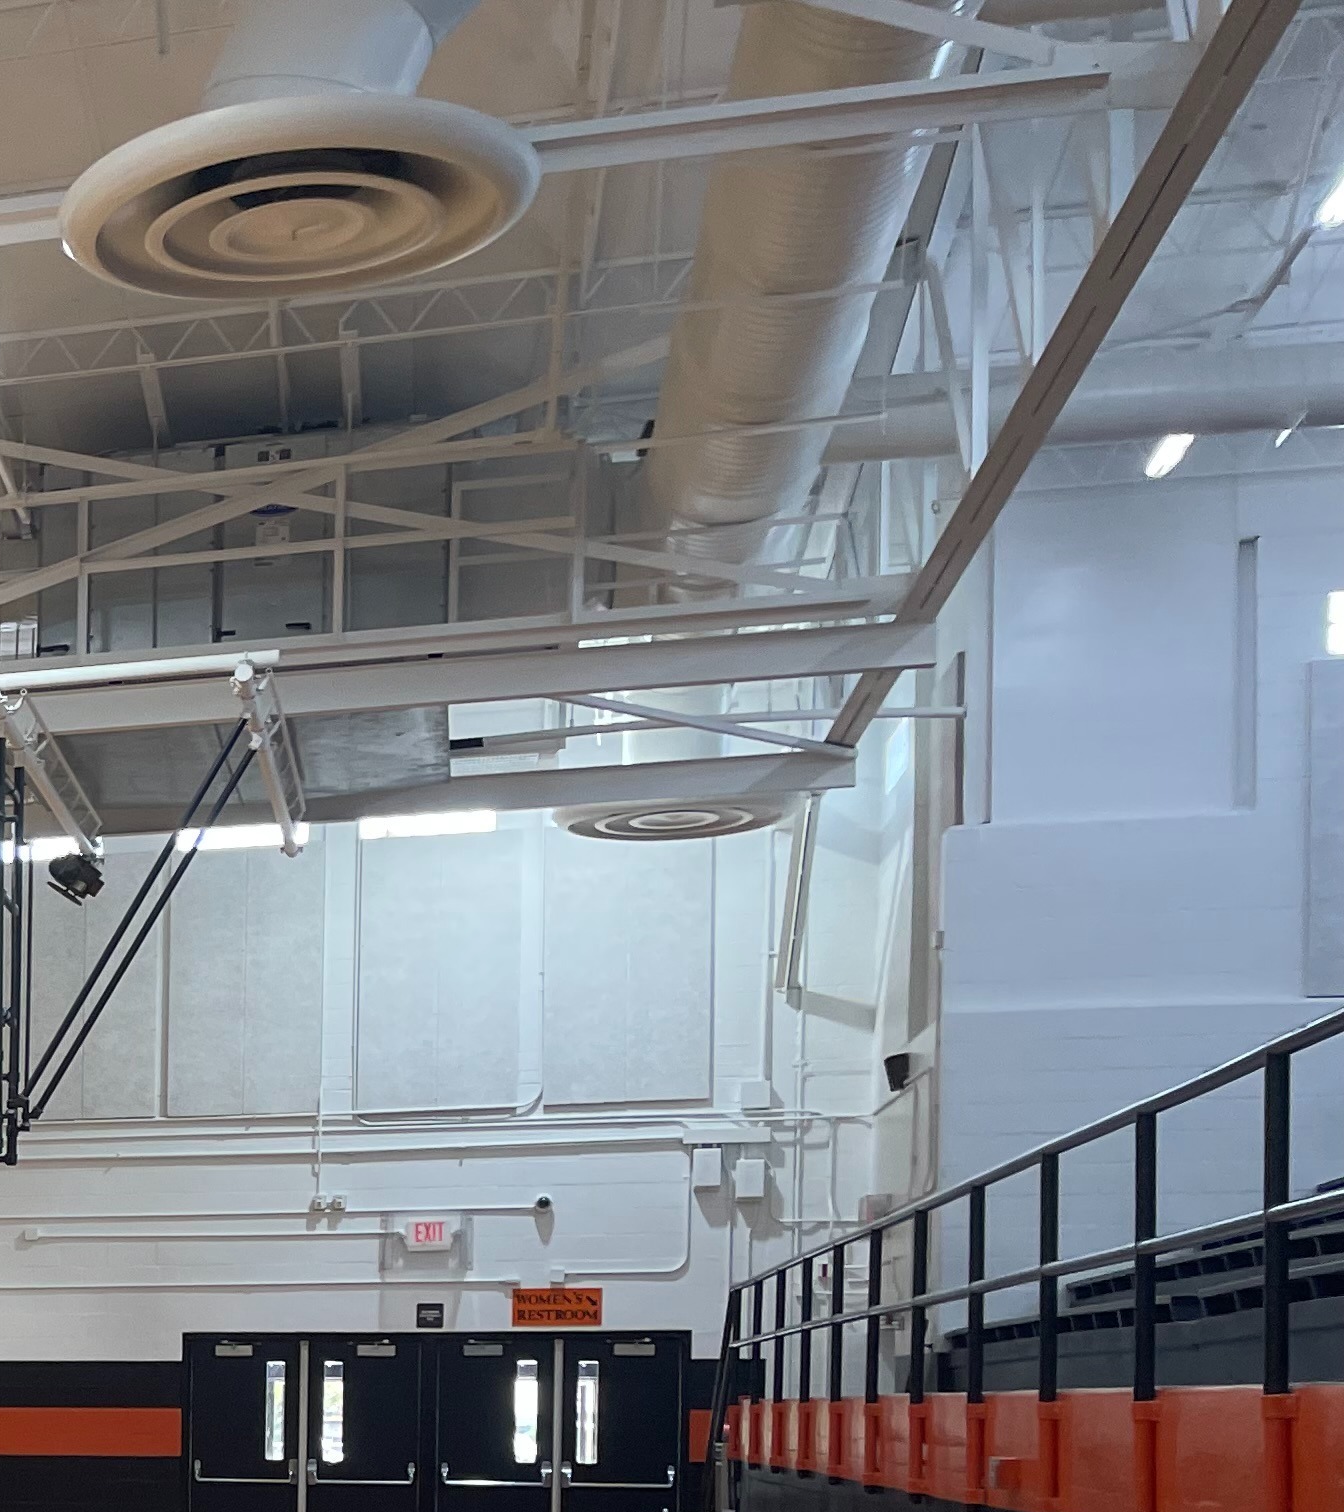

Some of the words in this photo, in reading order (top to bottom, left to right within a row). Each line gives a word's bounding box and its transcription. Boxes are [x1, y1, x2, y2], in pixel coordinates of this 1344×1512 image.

[415, 1221, 444, 1242] EXIT
[516, 1291, 584, 1305] WOMEN'S
[516, 1309, 598, 1321] RESTROOM
